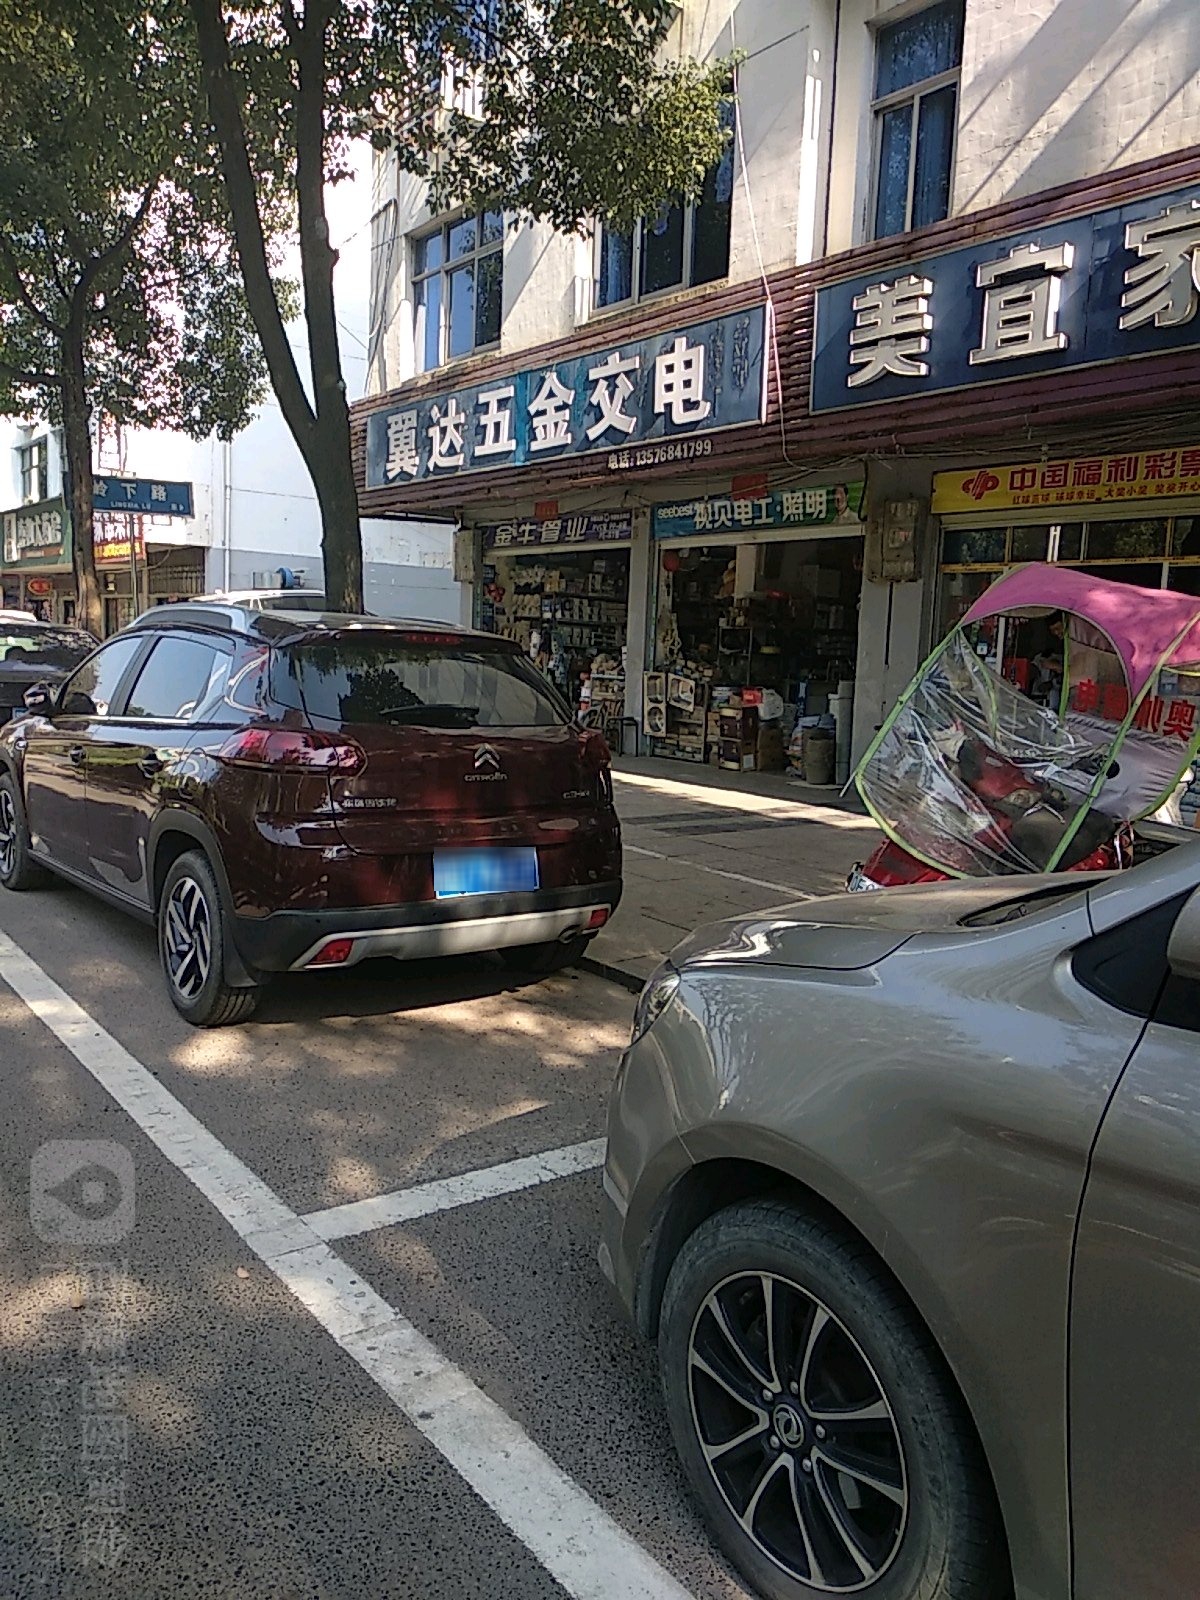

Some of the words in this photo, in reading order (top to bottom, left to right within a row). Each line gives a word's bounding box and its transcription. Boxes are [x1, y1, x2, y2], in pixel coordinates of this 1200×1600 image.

[847, 199, 1200, 388] 美宜家
[386, 336, 711, 480] 翼达五金交电
[1009, 449, 1200, 491] 中国福利彩票
[493, 516, 588, 547] 金牛管业
[657, 505, 694, 519] seebest
